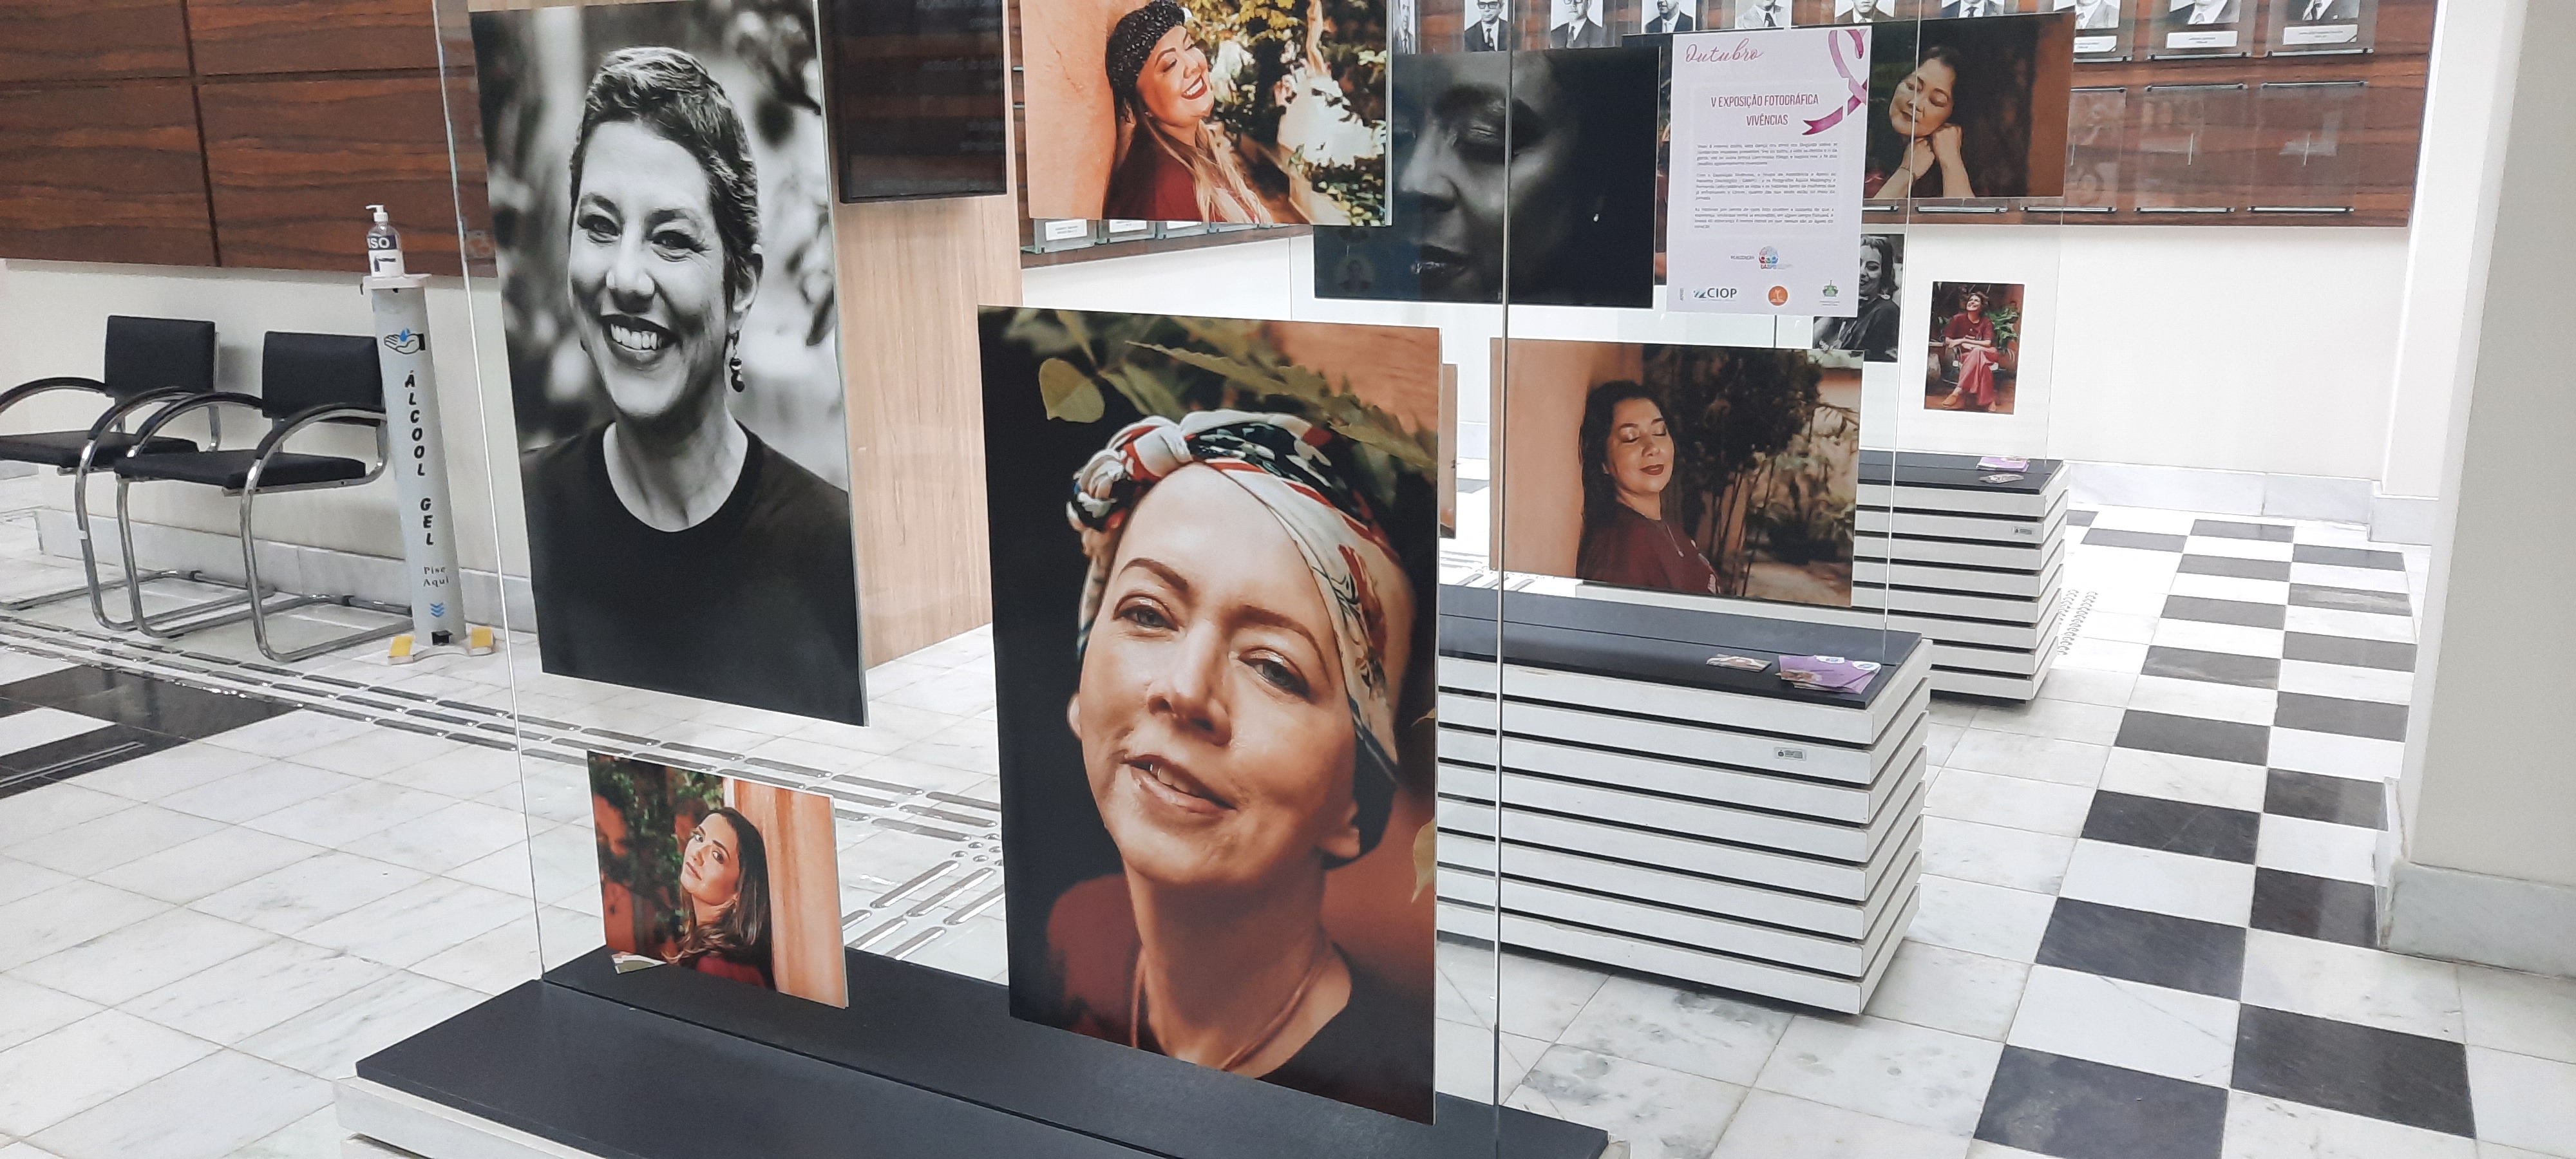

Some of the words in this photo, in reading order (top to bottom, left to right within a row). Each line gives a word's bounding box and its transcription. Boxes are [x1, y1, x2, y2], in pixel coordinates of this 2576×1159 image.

[1685, 37, 1764, 62] Outubro
[1710, 97, 1717, 108] V
[1718, 94, 1763, 108] EXPOSIÇÃO
[1765, 93, 1819, 106] FOTOGRÁFICA
[1747, 113, 1788, 126] VIVÊNCIAS
[1707, 288, 1738, 299] CIOP
[404, 370, 426, 476] ÁLCOOL
[420, 497, 435, 546] GEL
[422, 575, 449, 587] Aqui
